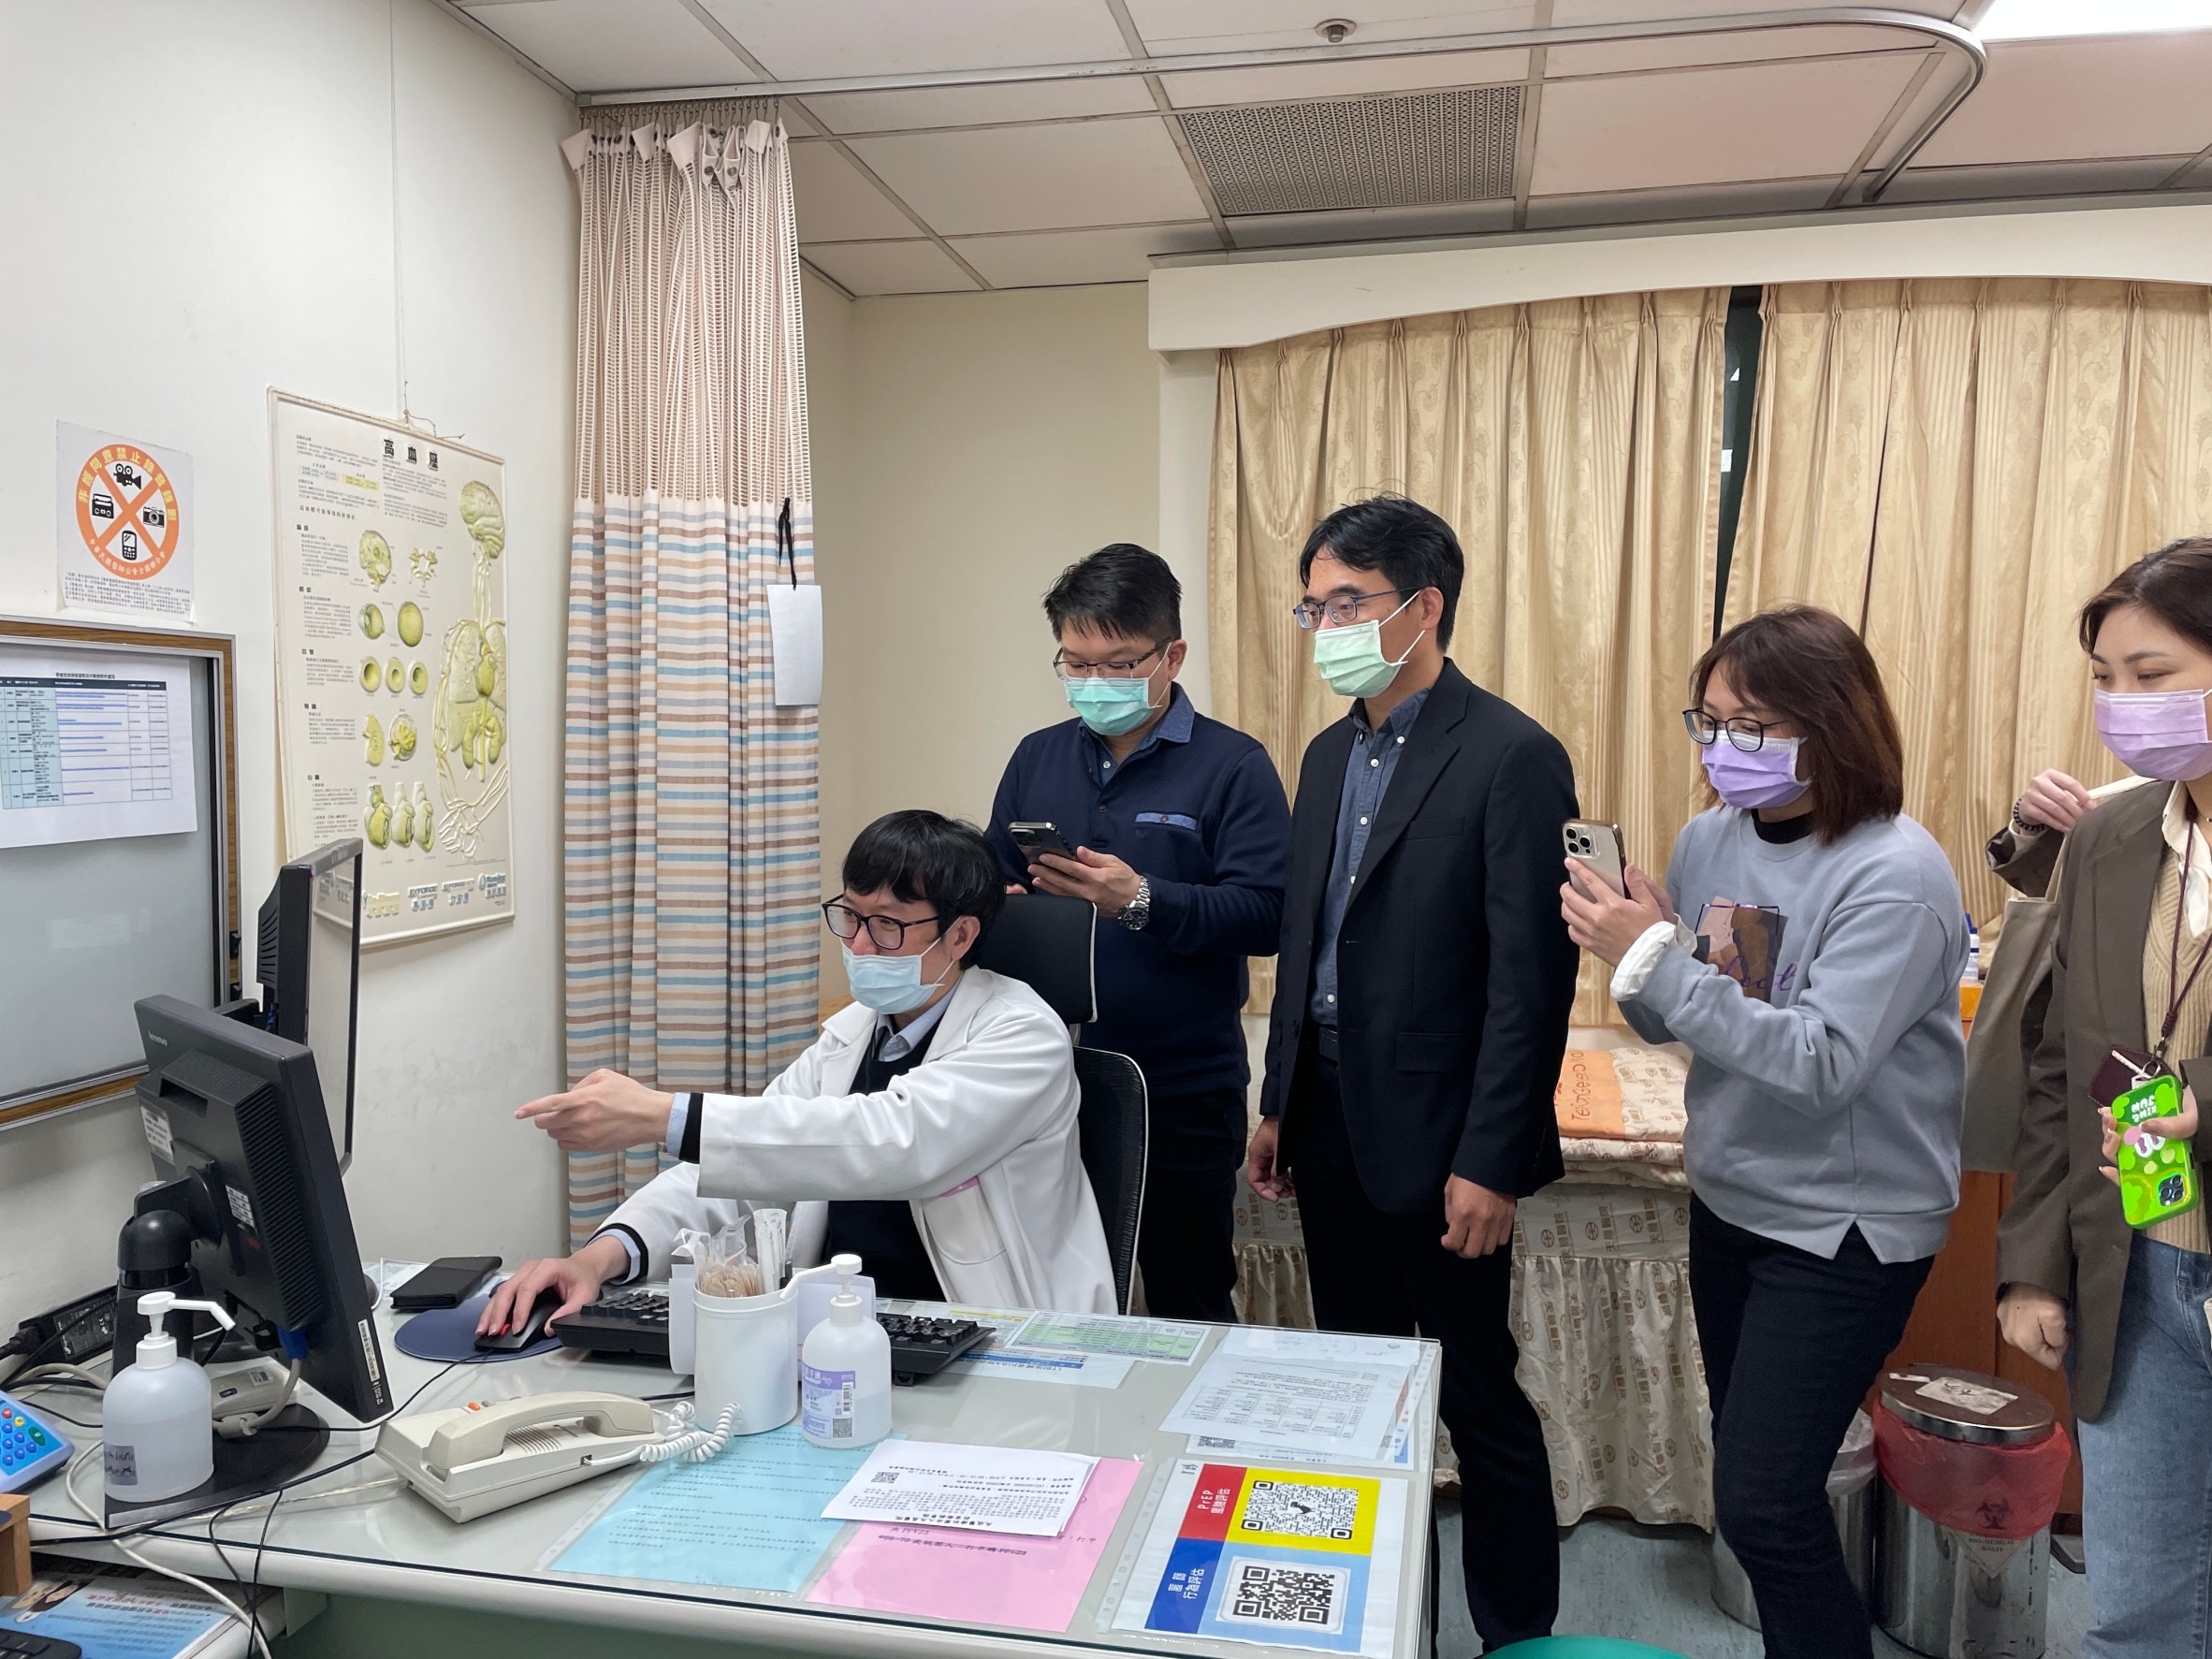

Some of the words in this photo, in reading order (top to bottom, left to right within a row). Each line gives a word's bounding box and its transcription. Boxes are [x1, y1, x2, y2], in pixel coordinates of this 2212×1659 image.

[383, 439, 439, 469] 高血壓
[409, 885, 438, 896] EXFORGE
[148, 1029, 168, 1047] lenovo
[2132, 1095, 2155, 1113] JUN
[1198, 1490, 1214, 1509] PrEP
[1211, 1488, 1231, 1514] 風險評估
[1183, 1567, 1205, 1599] 行為評估
